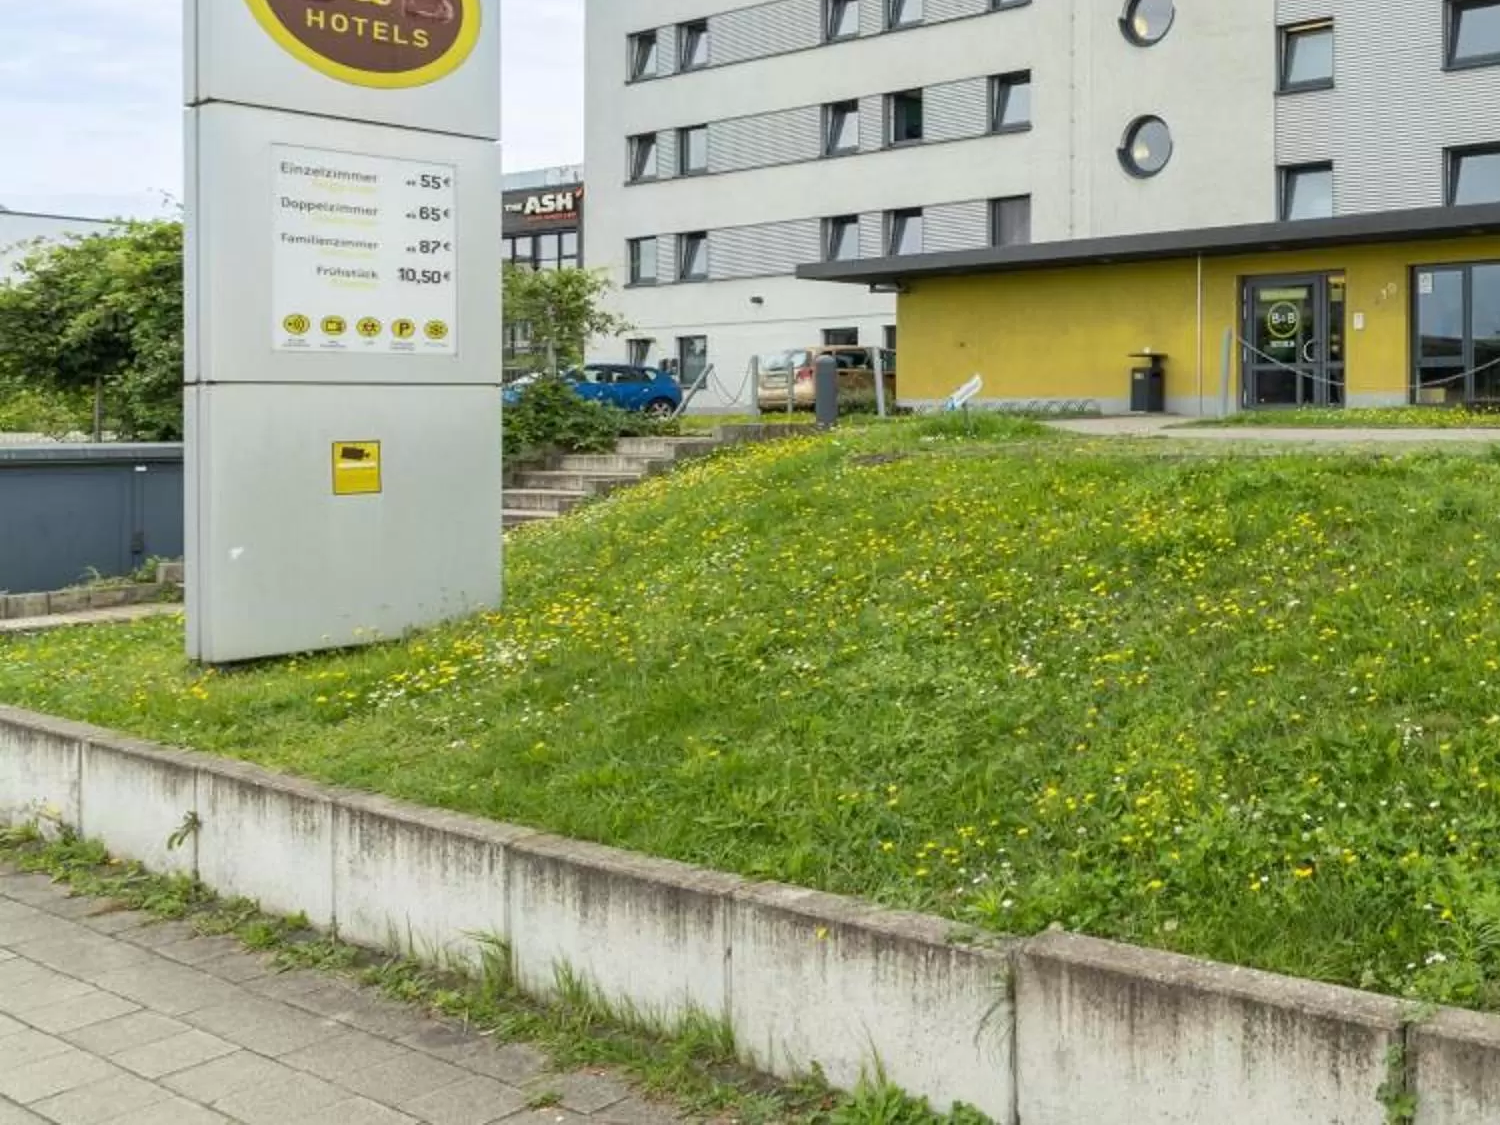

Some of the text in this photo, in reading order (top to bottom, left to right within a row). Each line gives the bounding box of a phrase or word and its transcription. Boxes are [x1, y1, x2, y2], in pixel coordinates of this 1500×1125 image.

[305, 7, 431, 49] HOTELS
[280, 161, 378, 183] Einzelzimmer
[280, 196, 379, 217] Doppelzimmer
[523, 192, 573, 215] ASH
[280, 232, 380, 250] Familienzimmer
[316, 266, 380, 280] Frühstück
